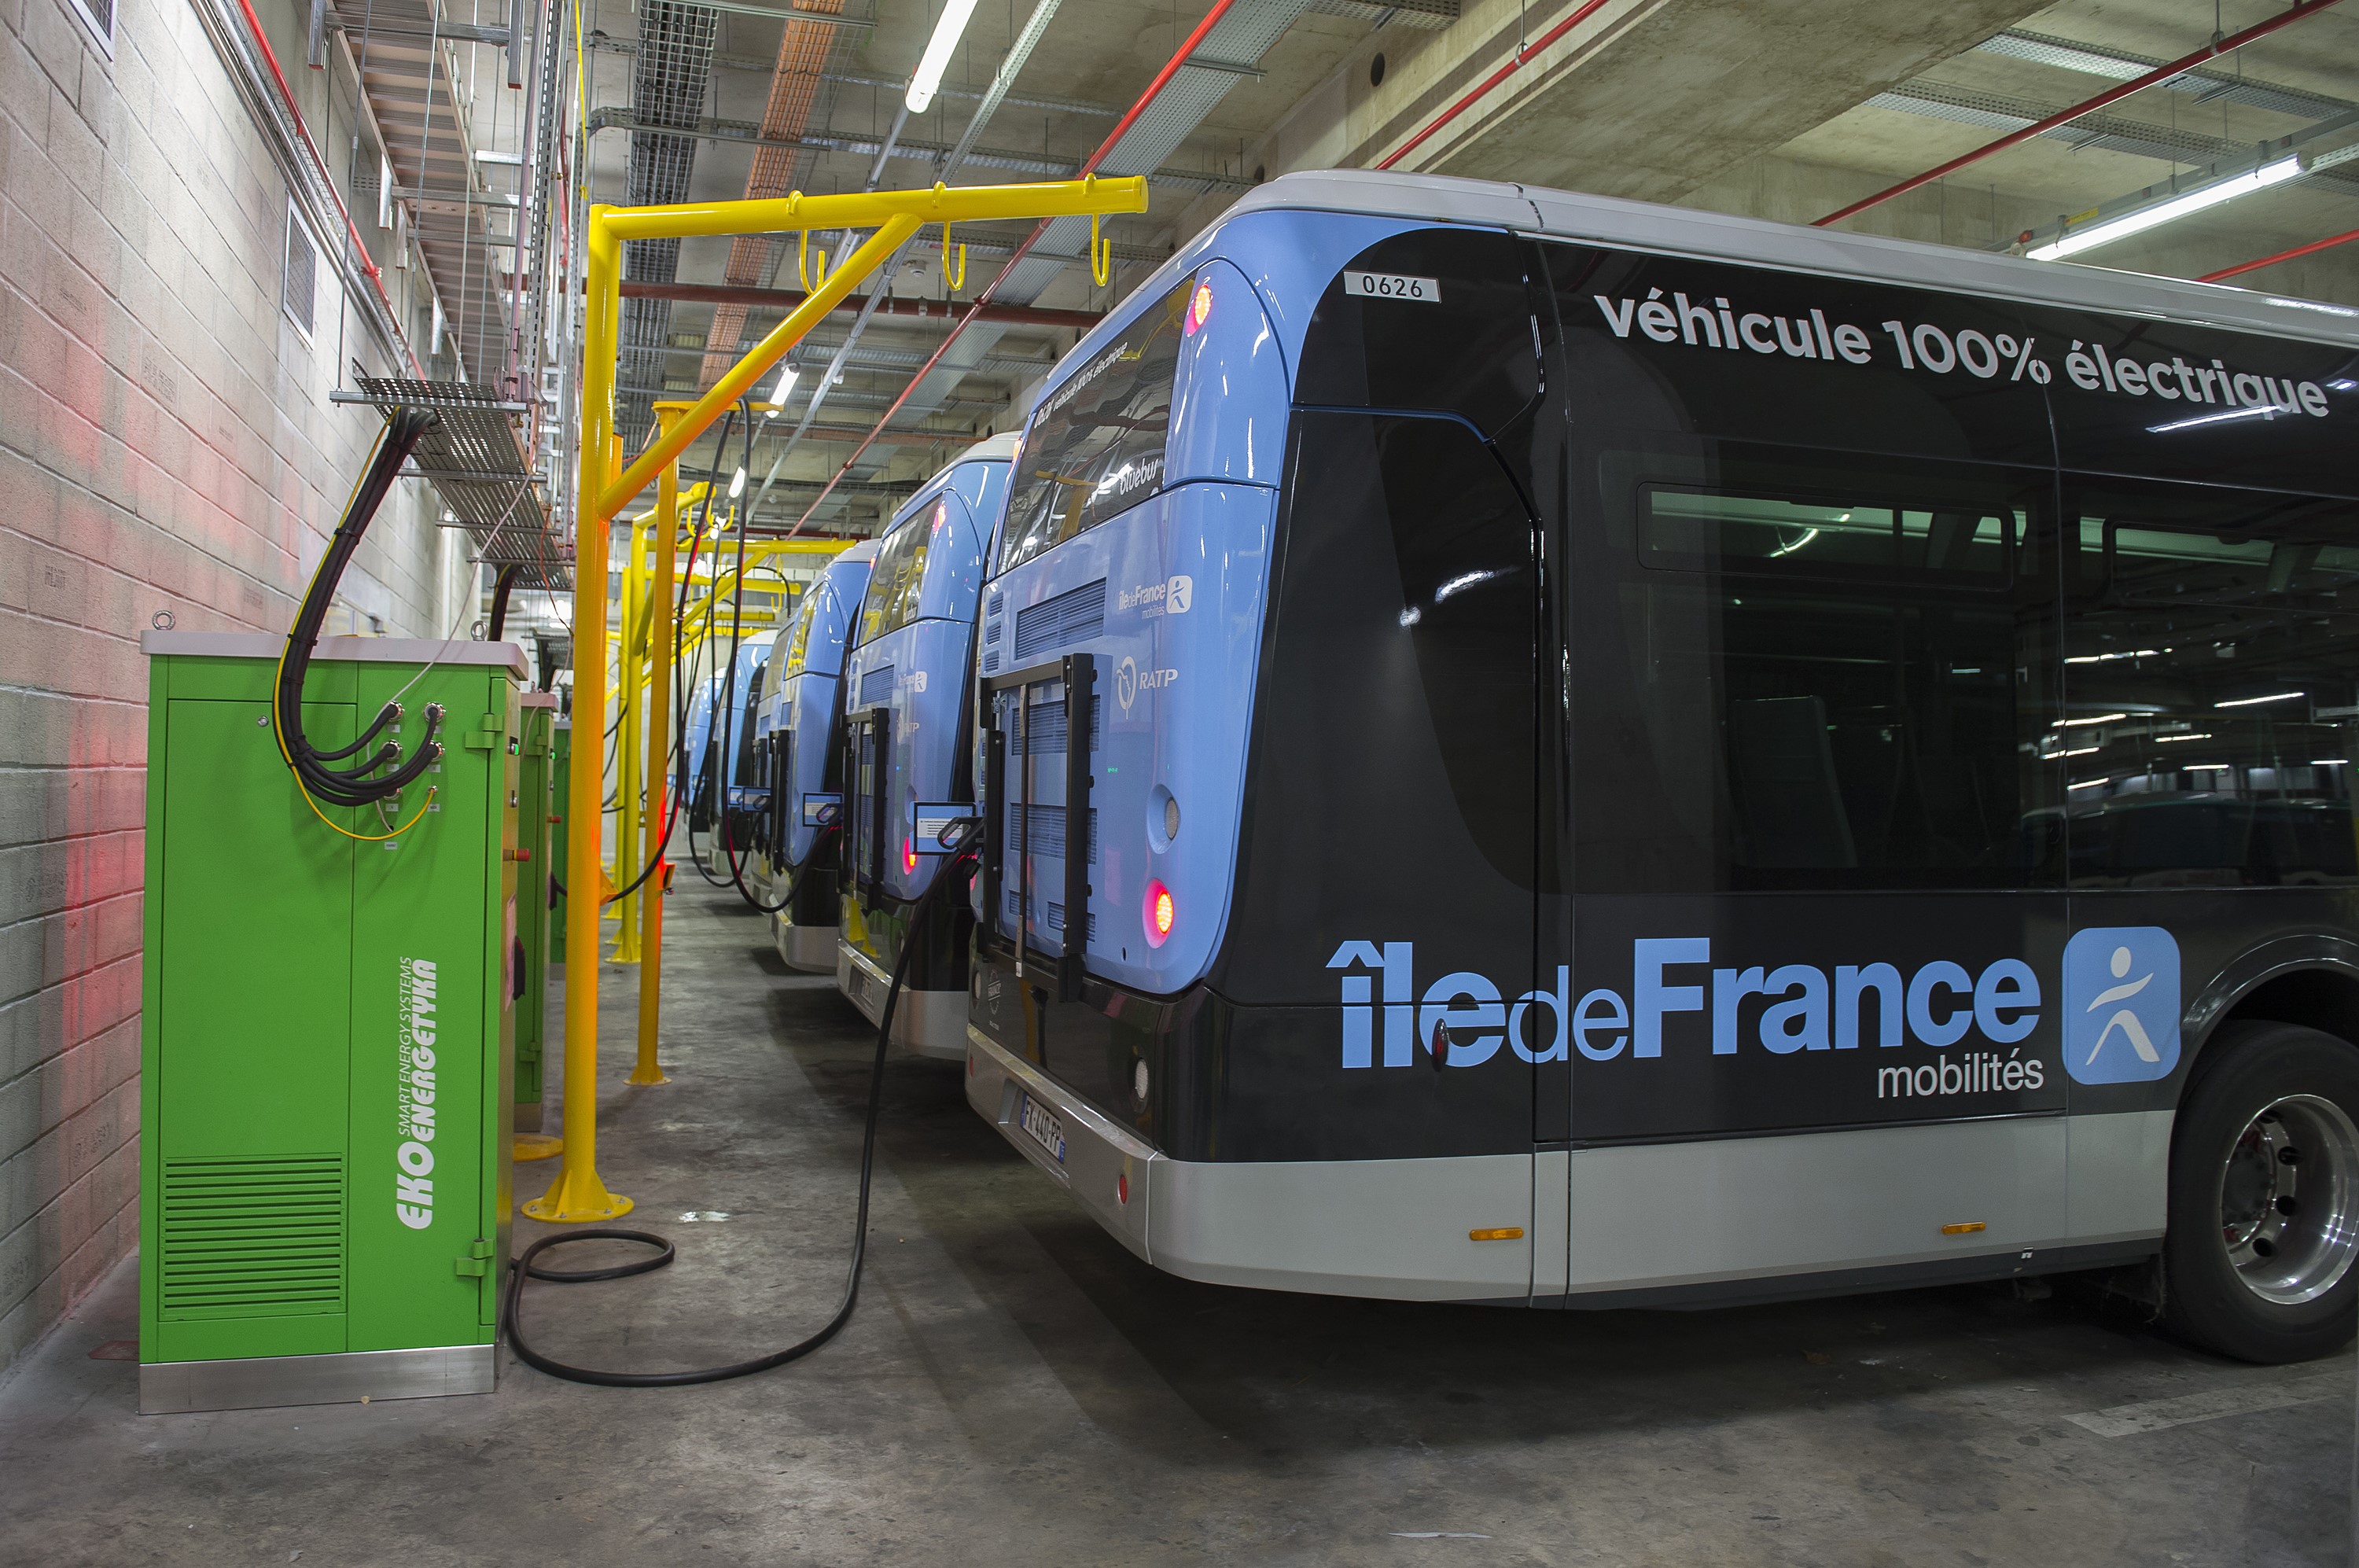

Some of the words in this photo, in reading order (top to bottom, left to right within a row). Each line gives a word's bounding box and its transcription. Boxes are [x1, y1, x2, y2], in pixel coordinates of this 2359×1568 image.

[1362, 274, 1423, 298] 0626
[1593, 287, 1871, 364] véhicule
[1882, 320, 2052, 385] 100%
[2064, 339, 2330, 421] électrique
[1139, 668, 1179, 690] RATP
[399, 956, 412, 1023] SYSTEMS
[399, 1023, 411, 1083] ENERGY
[1878, 1048, 2045, 1098] mobilités
[398, 1084, 411, 1137] SMART
